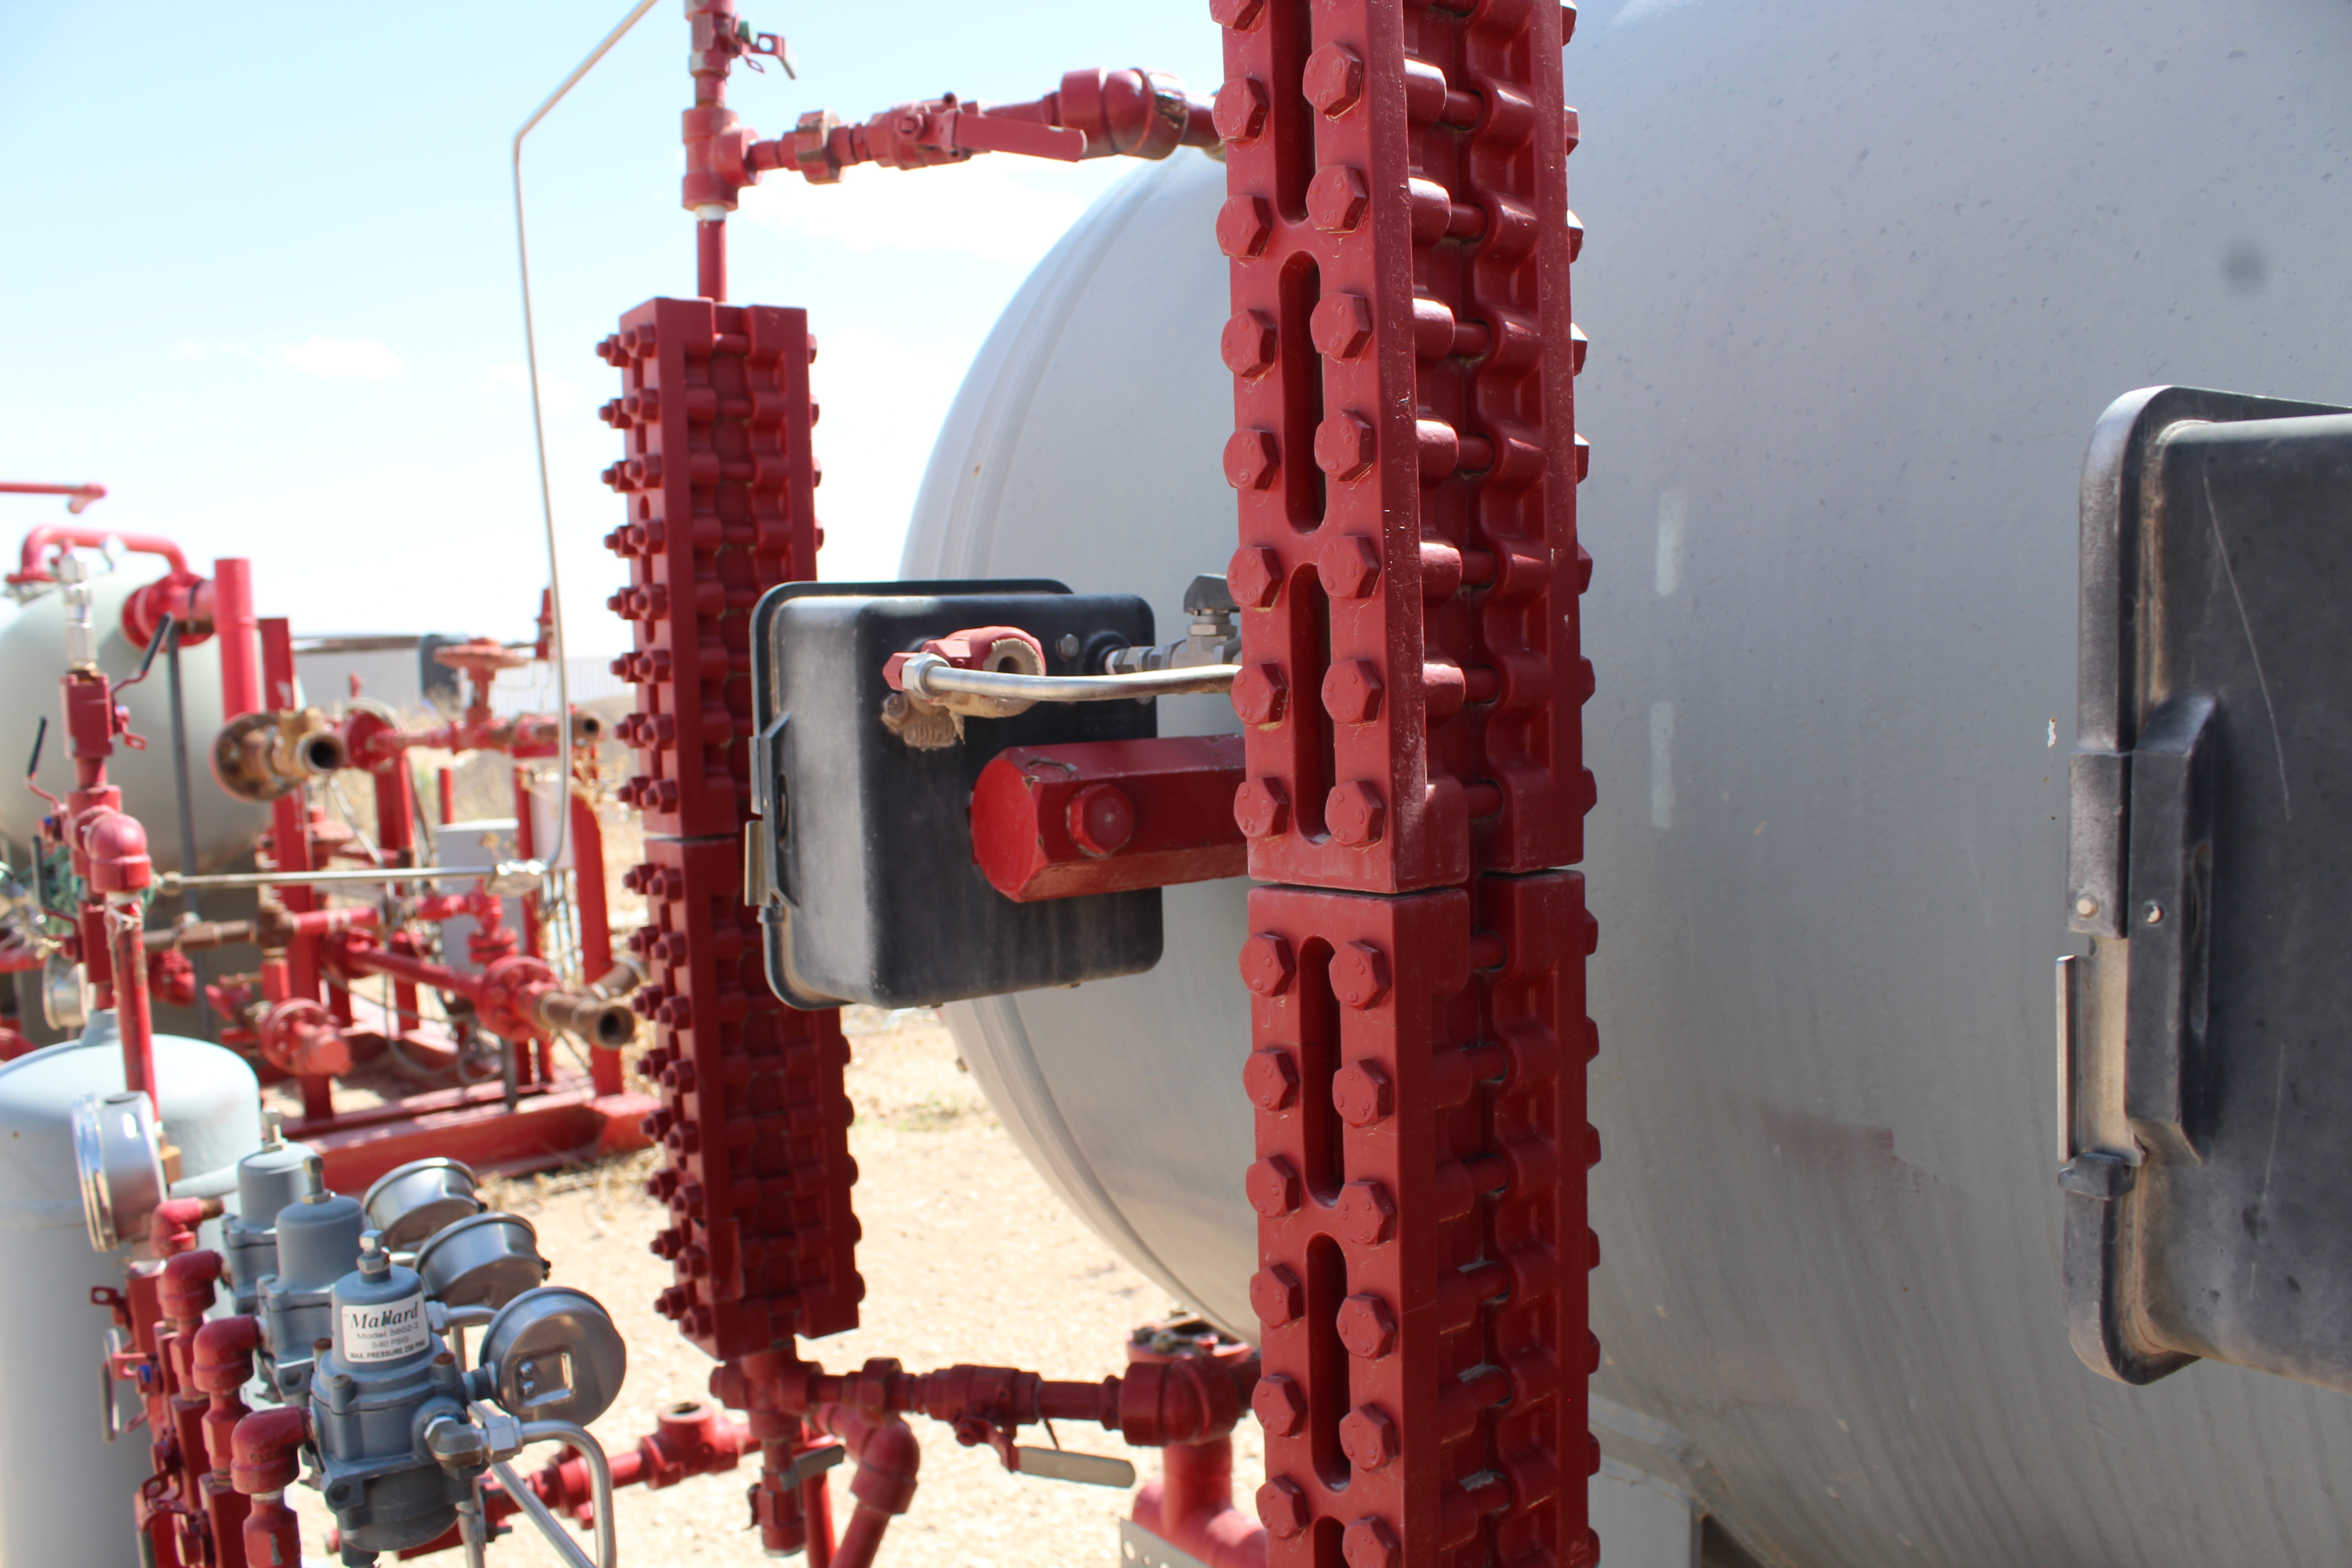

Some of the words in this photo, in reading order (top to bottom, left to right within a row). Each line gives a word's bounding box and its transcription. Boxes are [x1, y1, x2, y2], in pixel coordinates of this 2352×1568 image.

[350, 1301, 419, 1329] Mallard
[357, 1331, 387, 1339] Model
[367, 1346, 402, 1358] PRESSURE
